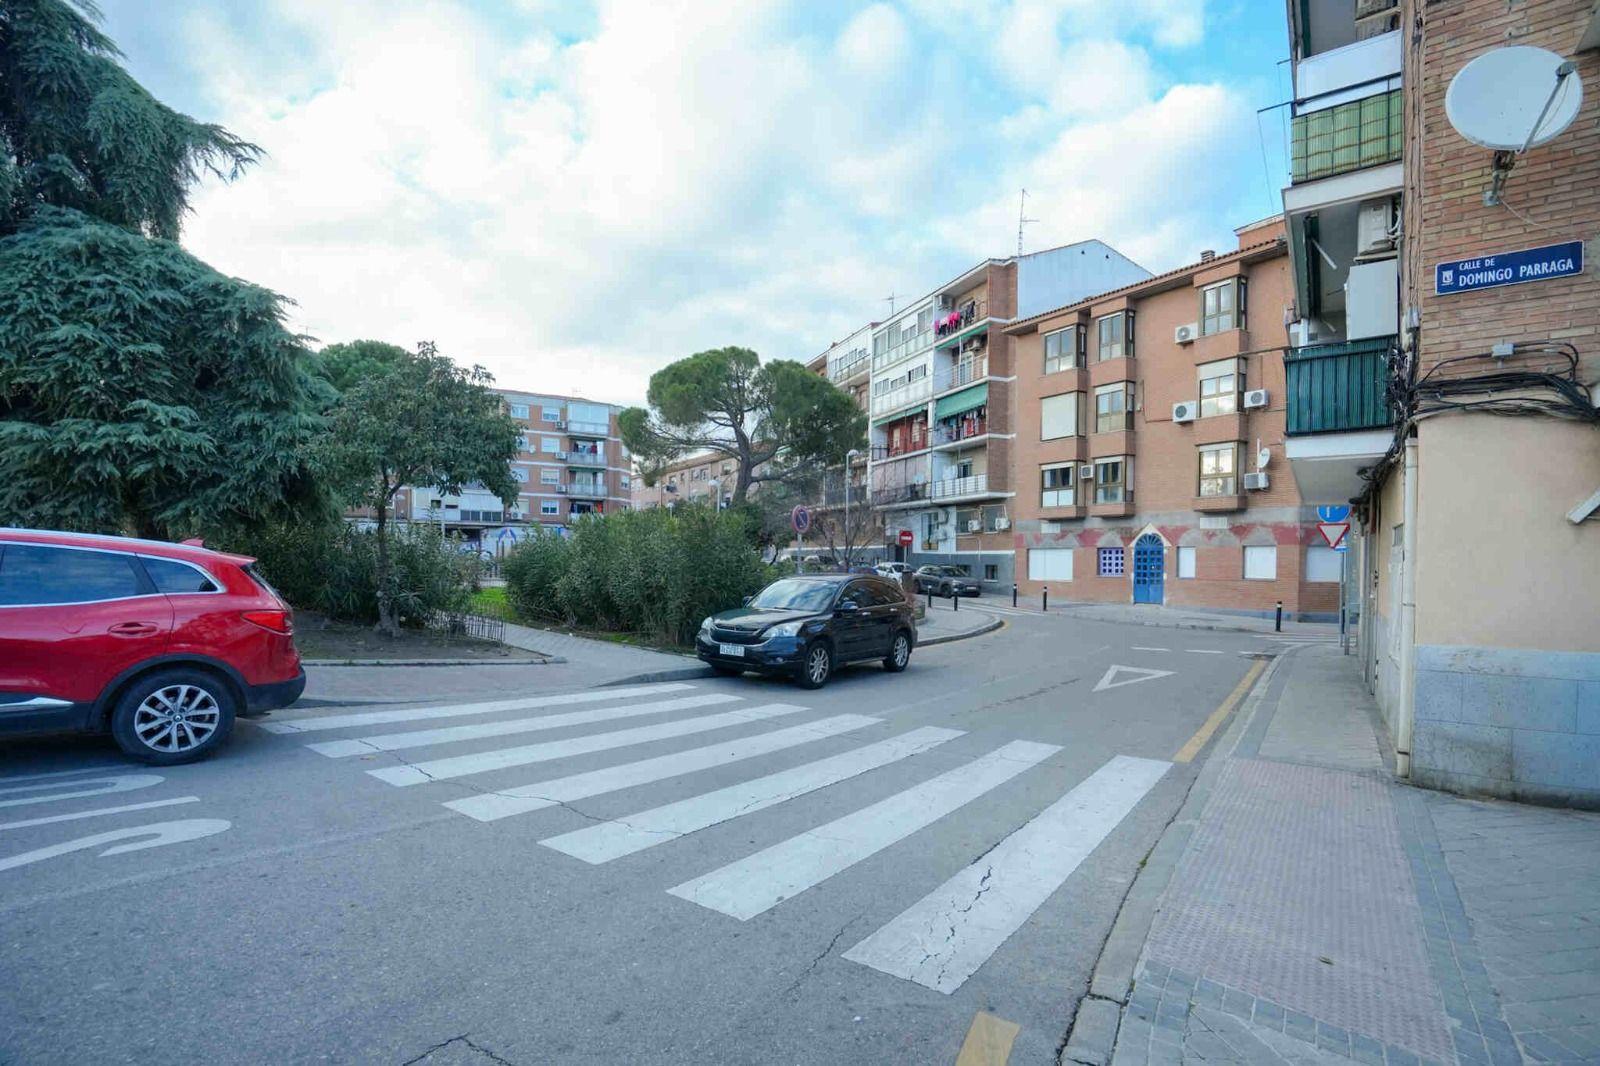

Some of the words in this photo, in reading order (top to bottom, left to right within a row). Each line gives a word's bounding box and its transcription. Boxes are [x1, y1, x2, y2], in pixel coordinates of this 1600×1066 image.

[1459, 260, 1481, 270] CALLE
[1485, 258, 1495, 267] DE
[1459, 268, 1512, 287] DOMINGO
[1520, 258, 1574, 277] PARRAGA
